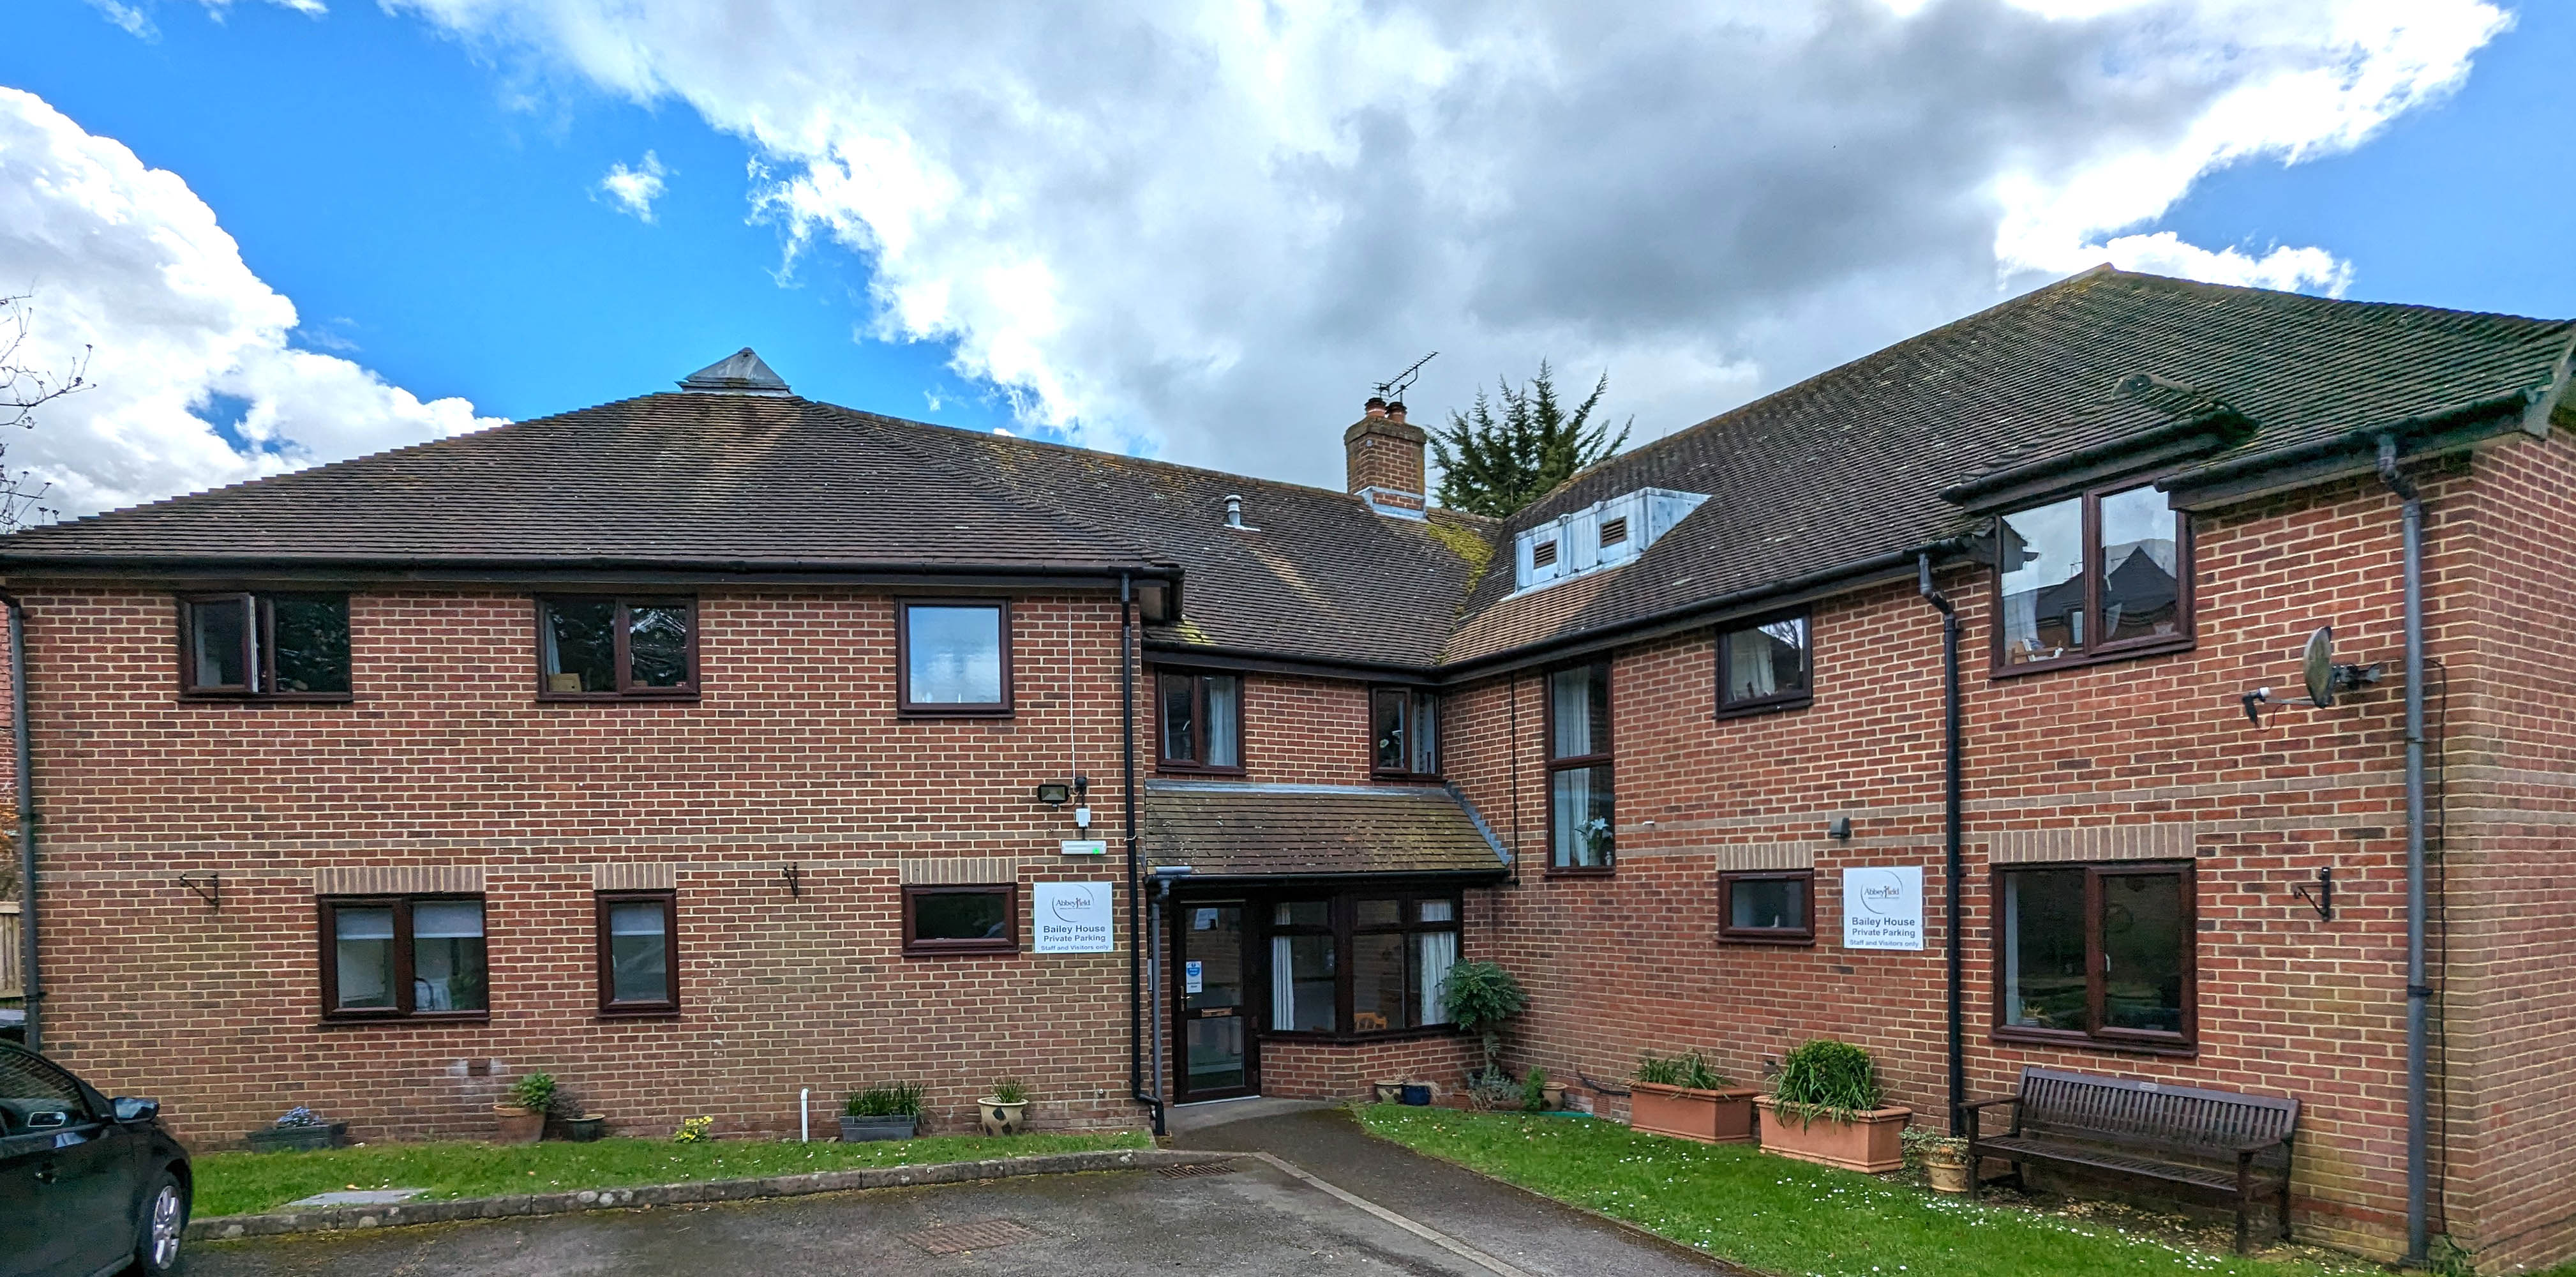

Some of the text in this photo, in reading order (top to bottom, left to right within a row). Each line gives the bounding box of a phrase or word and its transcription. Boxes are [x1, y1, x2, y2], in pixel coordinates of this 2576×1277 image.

[1852, 917, 1915, 927] Bailey House
[1044, 925, 1072, 934] Bailey
[1883, 929, 1915, 938] Parking
